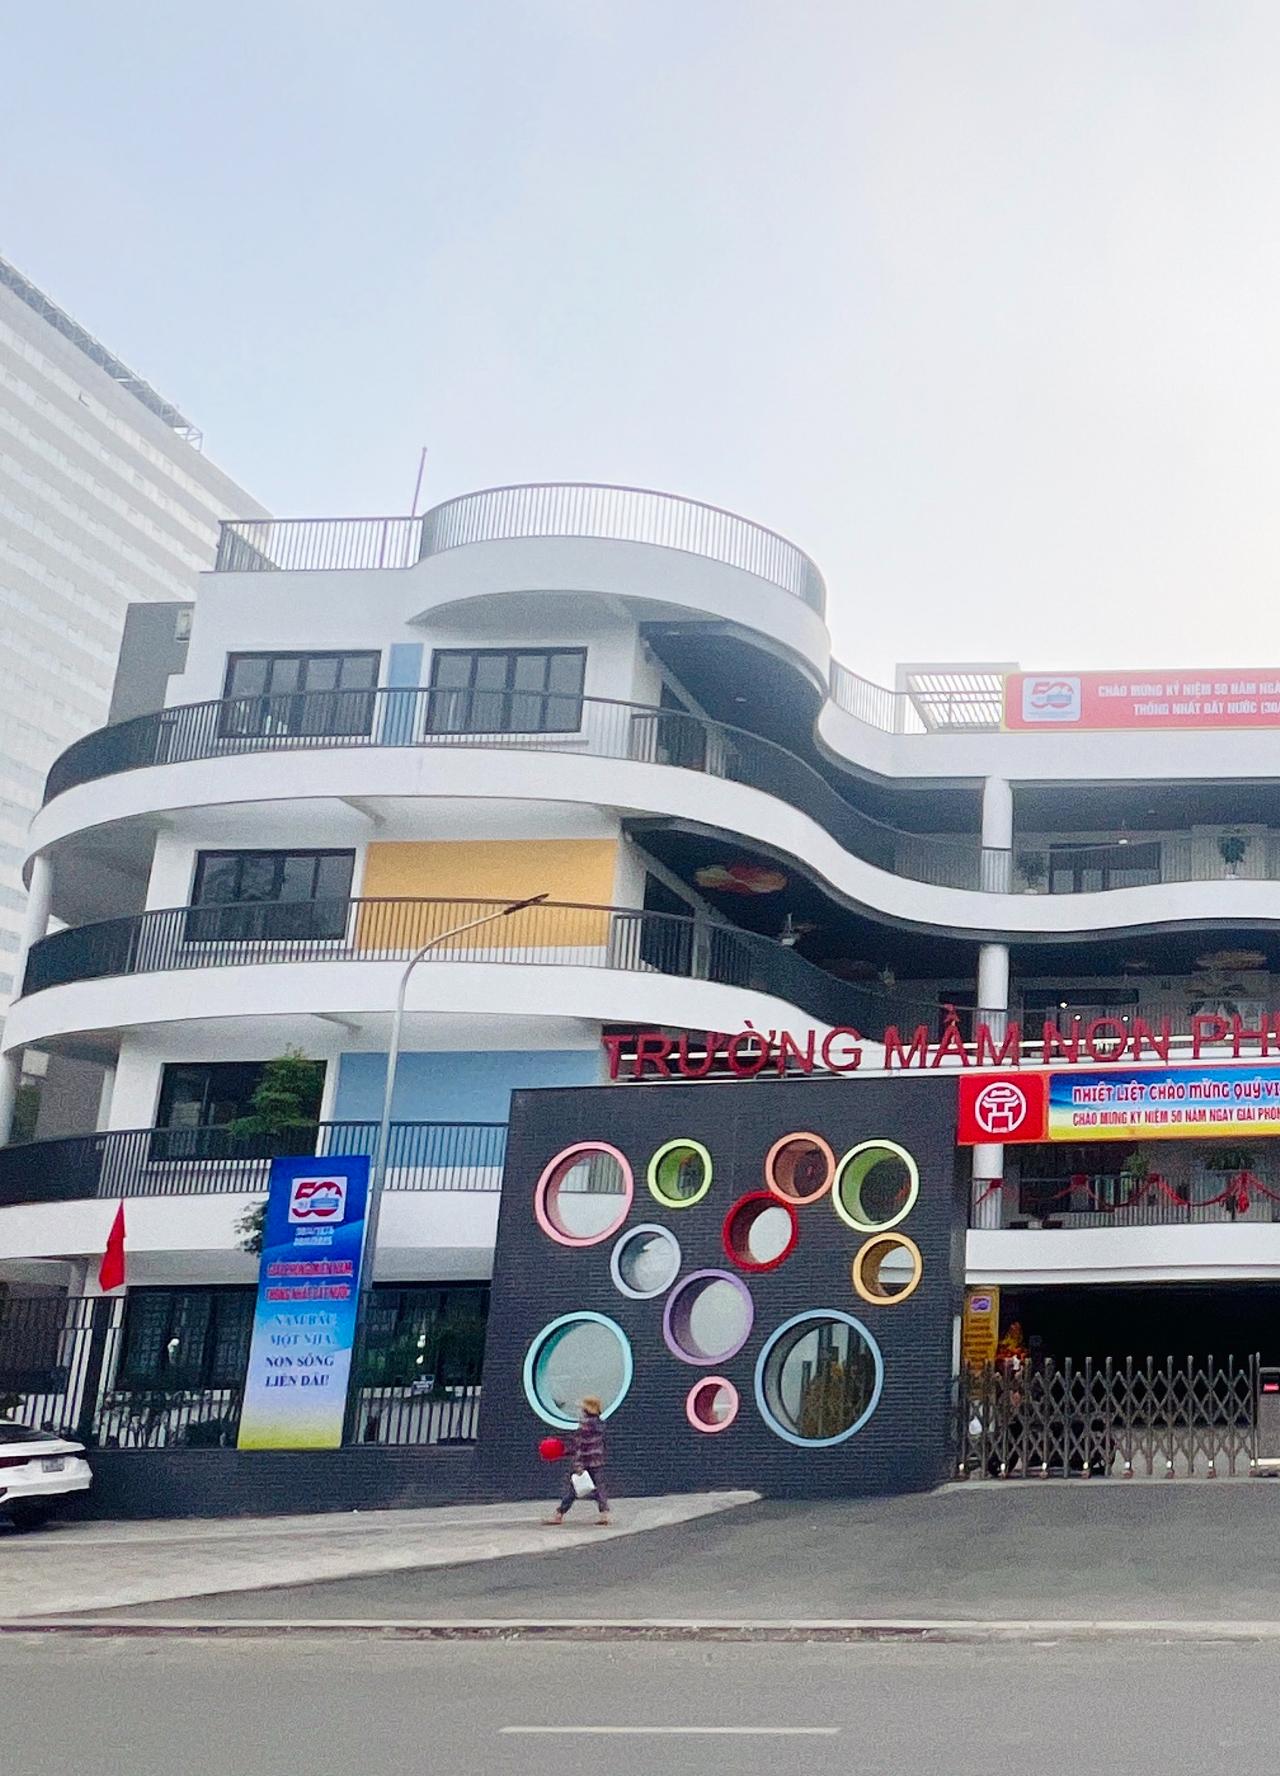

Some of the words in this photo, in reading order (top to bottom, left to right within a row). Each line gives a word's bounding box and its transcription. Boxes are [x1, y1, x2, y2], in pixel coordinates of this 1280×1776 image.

[602, 1019, 863, 1080] TRƯỜNG
[883, 1003, 1019, 1070] MẦM
[1043, 1014, 1171, 1065] NON
[1073, 1082, 1112, 1103] NHIỆT
[1116, 1080, 1146, 1103] LIỆT
[1149, 1079, 1185, 1101] CHÀO
[1189, 1078, 1230, 1099] MỪNG
[1233, 1077, 1261, 1100] QUÝ
[1073, 1110, 1097, 1126] CHÀO
[1145, 1108, 1169, 1127] NIỆM
[1171, 1110, 1182, 1123] 50
[1185, 1107, 1207, 1122] NĂM
[1209, 1107, 1234, 1122] NGÀY
[1236, 1103, 1255, 1121] GIẢI
[291, 1181, 343, 1218] 50
[265, 1356, 293, 1367] NON
[297, 1352, 334, 1367] SÔNG
